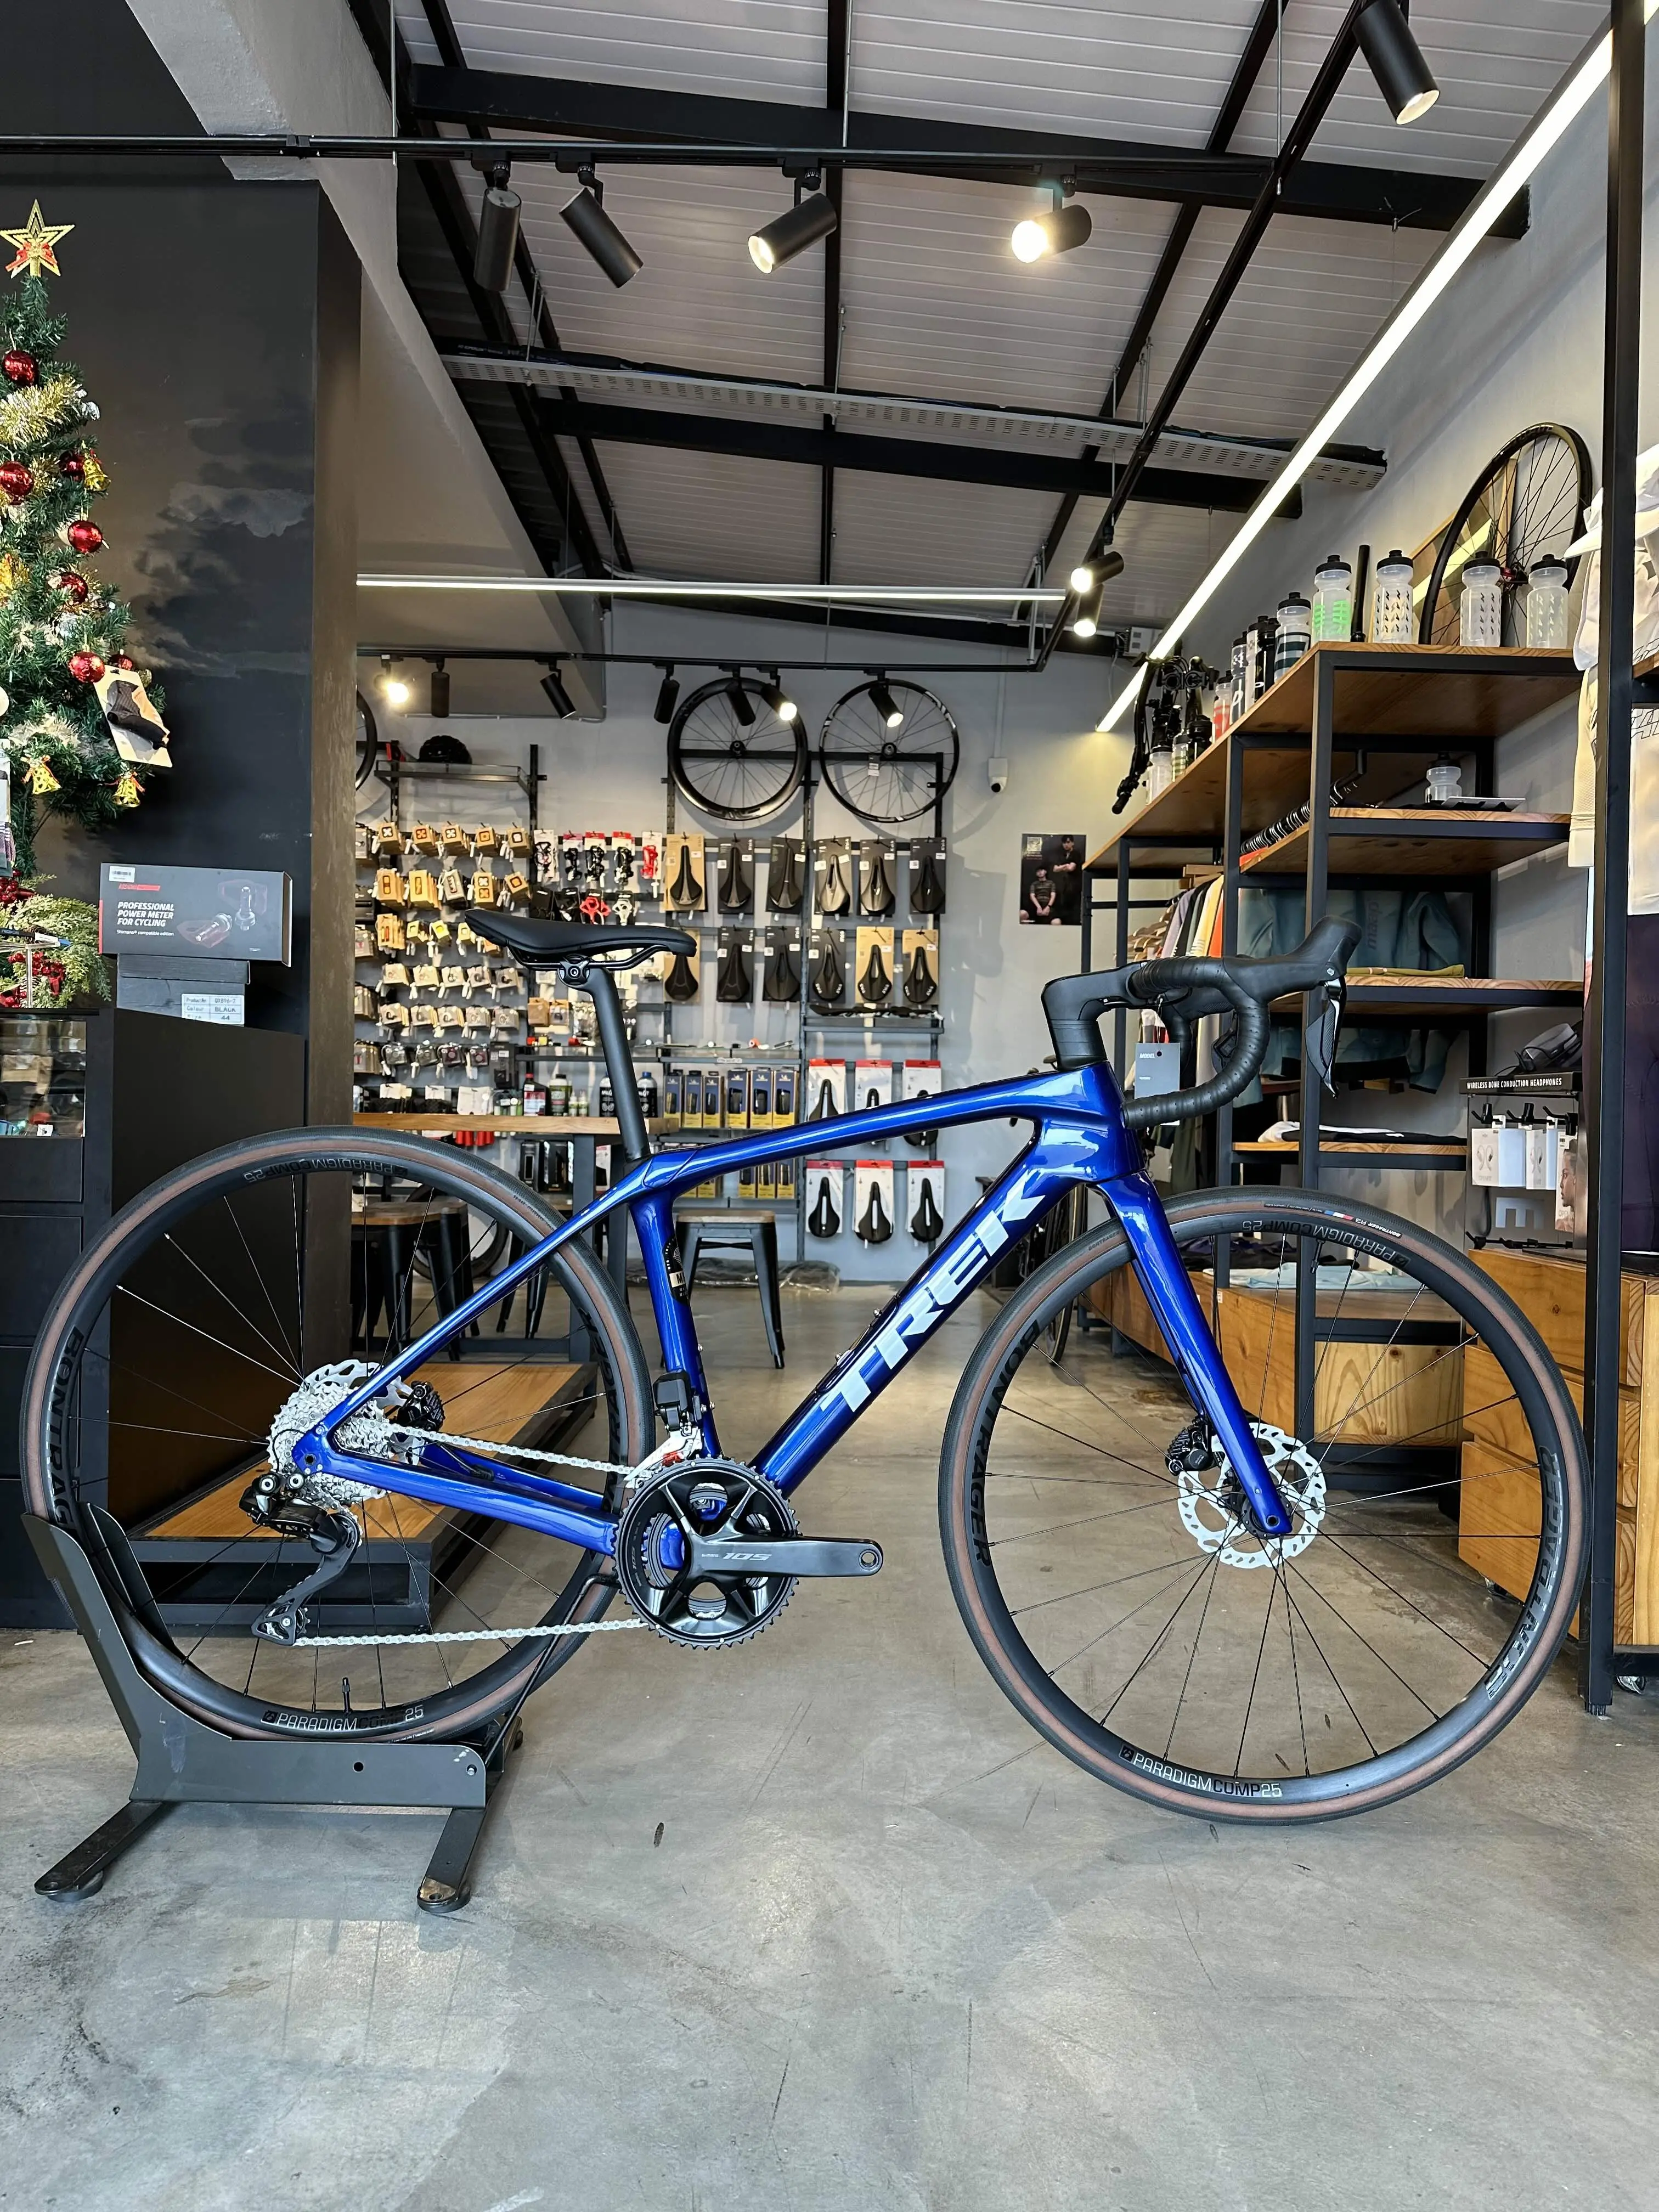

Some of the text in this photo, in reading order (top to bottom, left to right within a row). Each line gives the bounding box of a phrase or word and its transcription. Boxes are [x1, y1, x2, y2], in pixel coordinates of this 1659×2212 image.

[117, 901, 174, 911] PROFESSIONAL
[117, 910, 146, 918] POWER
[134, 918, 166, 927] CYCLING
[1500, 1079, 1529, 1088] CONDUCTION
[1530, 1077, 1562, 1087] HEADPHONES
[1242, 1220, 1262, 1232] 25
[1355, 1217, 1402, 1238] BONTRAGER R3
[1314, 1225, 1395, 1261] PARADIGM
[820, 1169, 1046, 1413] TREK
[970, 1319, 1040, 1567] BONTRAGER
[723, 1552, 772, 1561] 105
[1483, 1446, 1564, 1700] BONTRAGER
[275, 1713, 357, 1731] PARADIGM
[404, 1704, 425, 1723] 25
[1133, 1751, 1283, 1798] PARADIGM COMP 25
